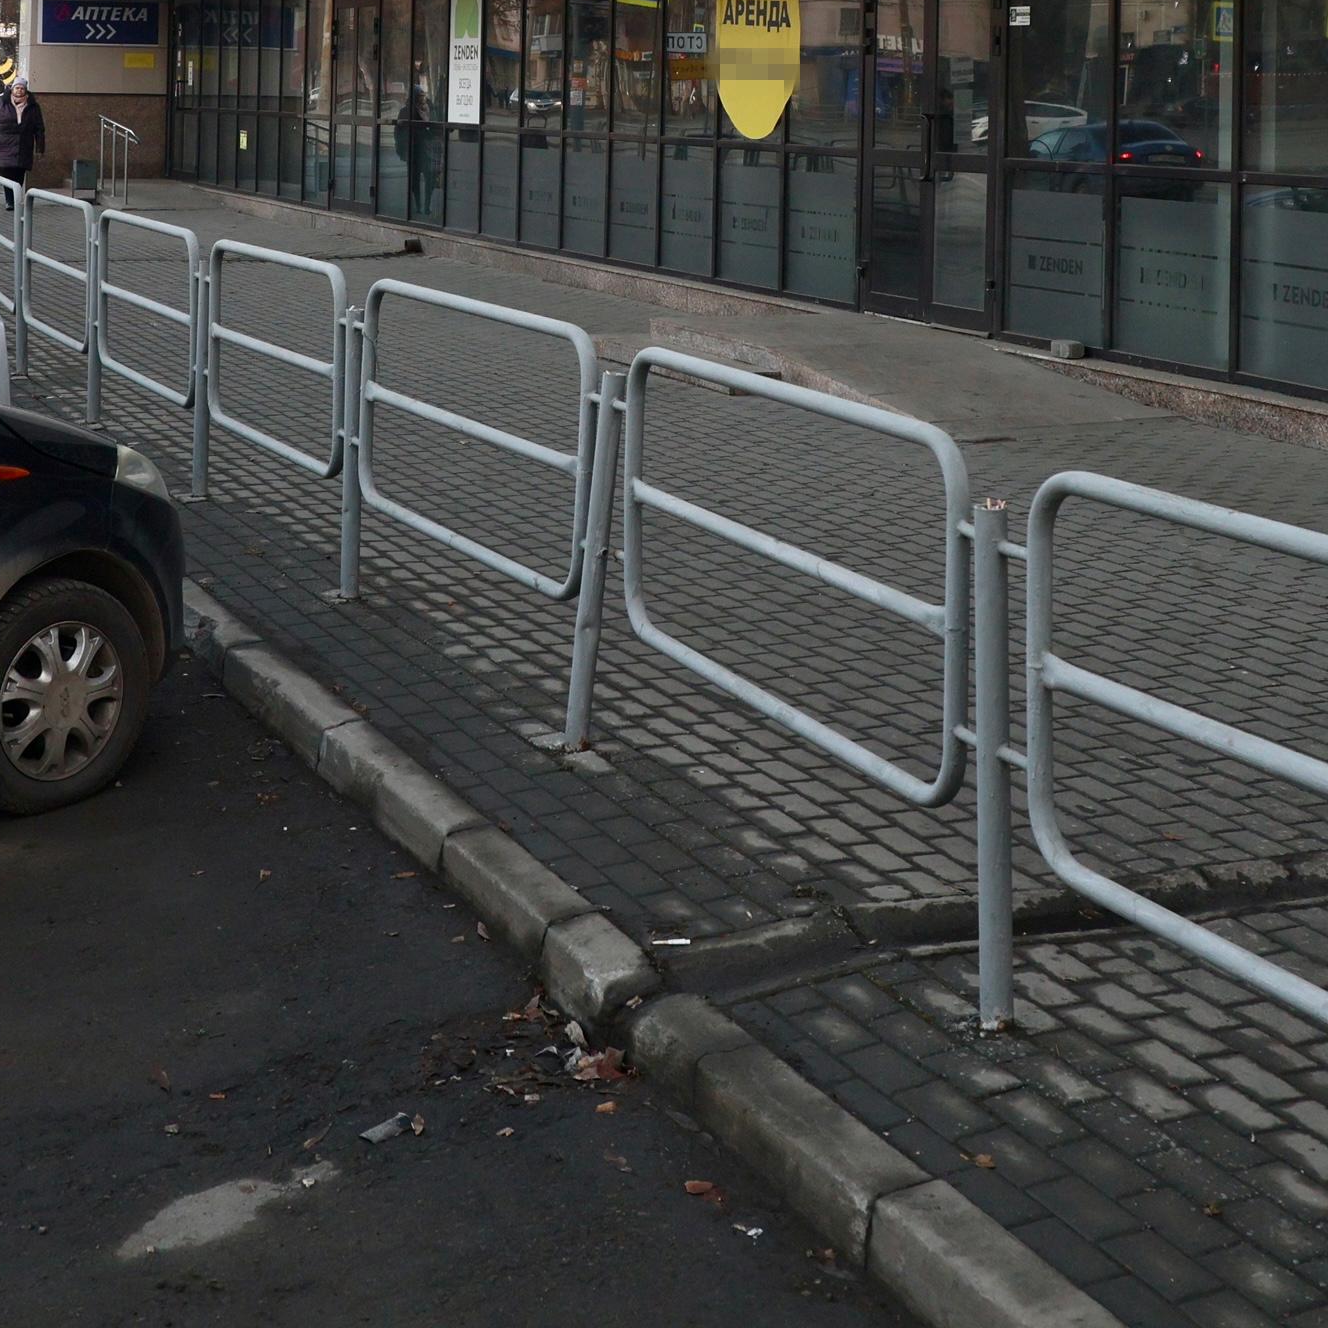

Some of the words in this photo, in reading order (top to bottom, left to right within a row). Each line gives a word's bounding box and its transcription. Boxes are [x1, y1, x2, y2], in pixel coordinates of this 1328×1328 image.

[71, 6, 148, 22] АПТЕКА
[722, 0, 791, 32] АРЕНДА
[454, 45, 479, 60] ZENDEN
[1039, 255, 1084, 276] ZENDEN
